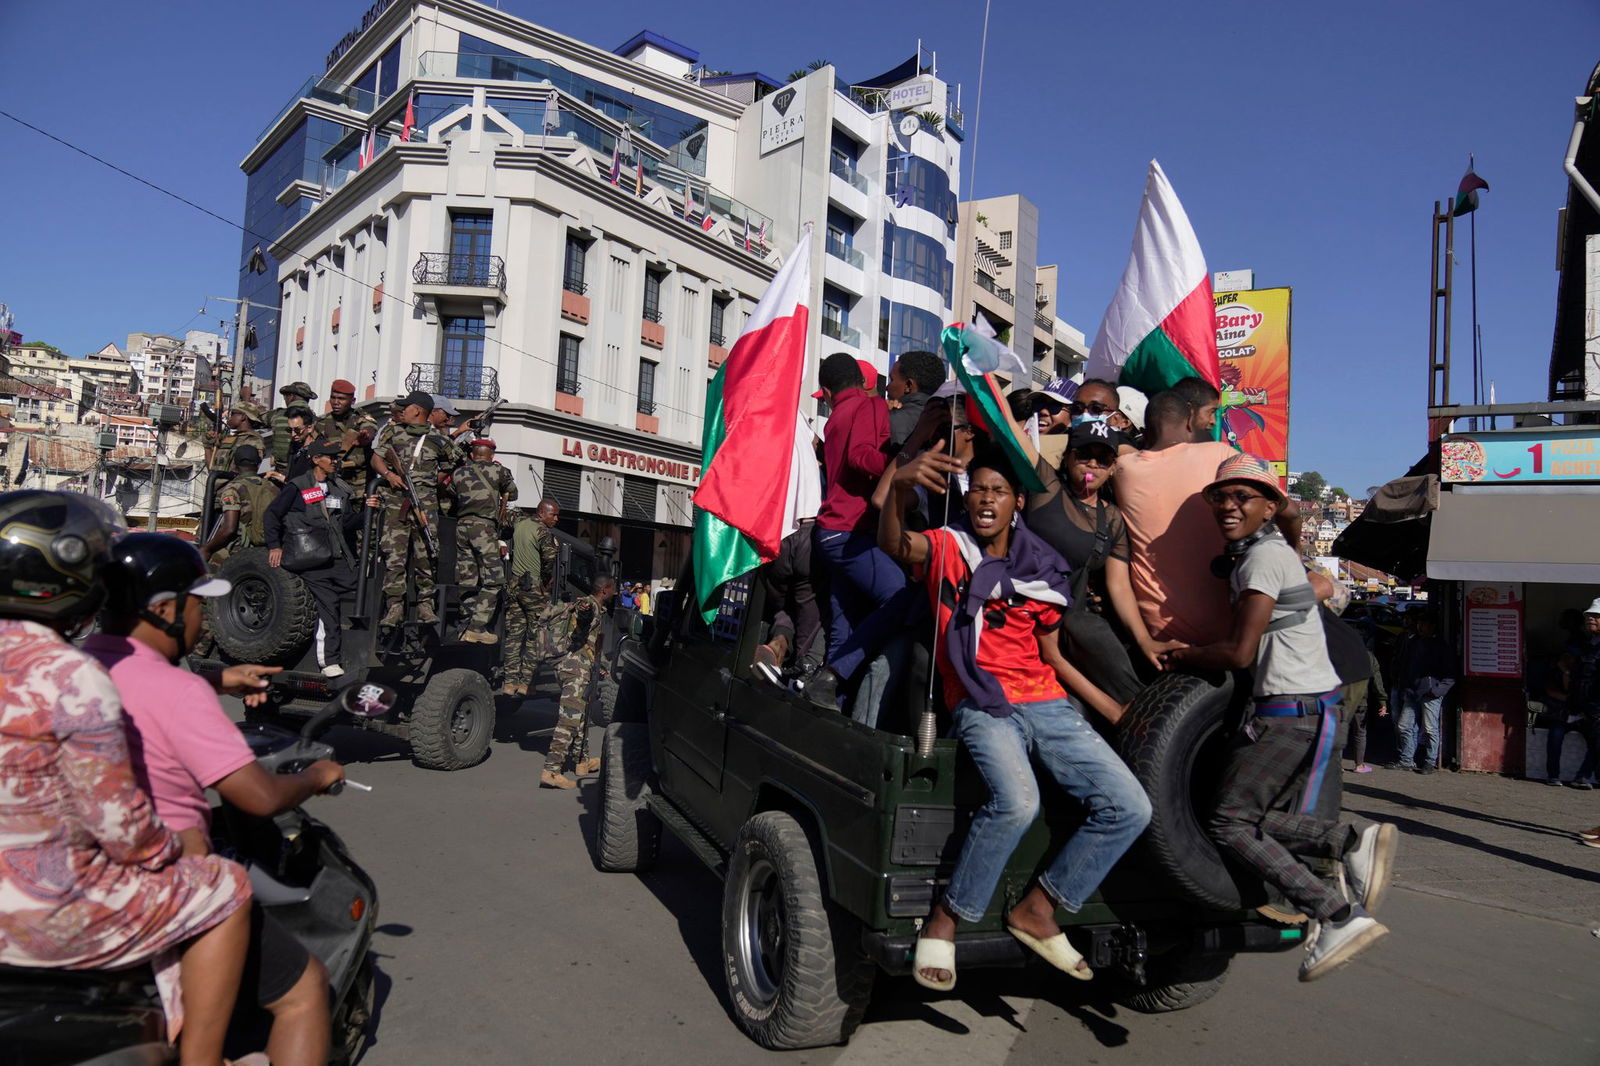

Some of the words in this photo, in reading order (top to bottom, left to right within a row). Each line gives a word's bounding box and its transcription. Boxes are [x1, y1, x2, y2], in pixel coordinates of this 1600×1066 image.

[893, 84, 930, 100] HOTEL
[763, 114, 804, 139] PIETRA
[1214, 292, 1239, 308] SUPER
[1216, 312, 1263, 329] Bary
[1090, 422, 1109, 438] NY
[1552, 439, 1593, 455] PIZZA
[562, 438, 583, 459] LA
[587, 444, 690, 480] GASTRONOMIE
[1527, 443, 1543, 474] 1
